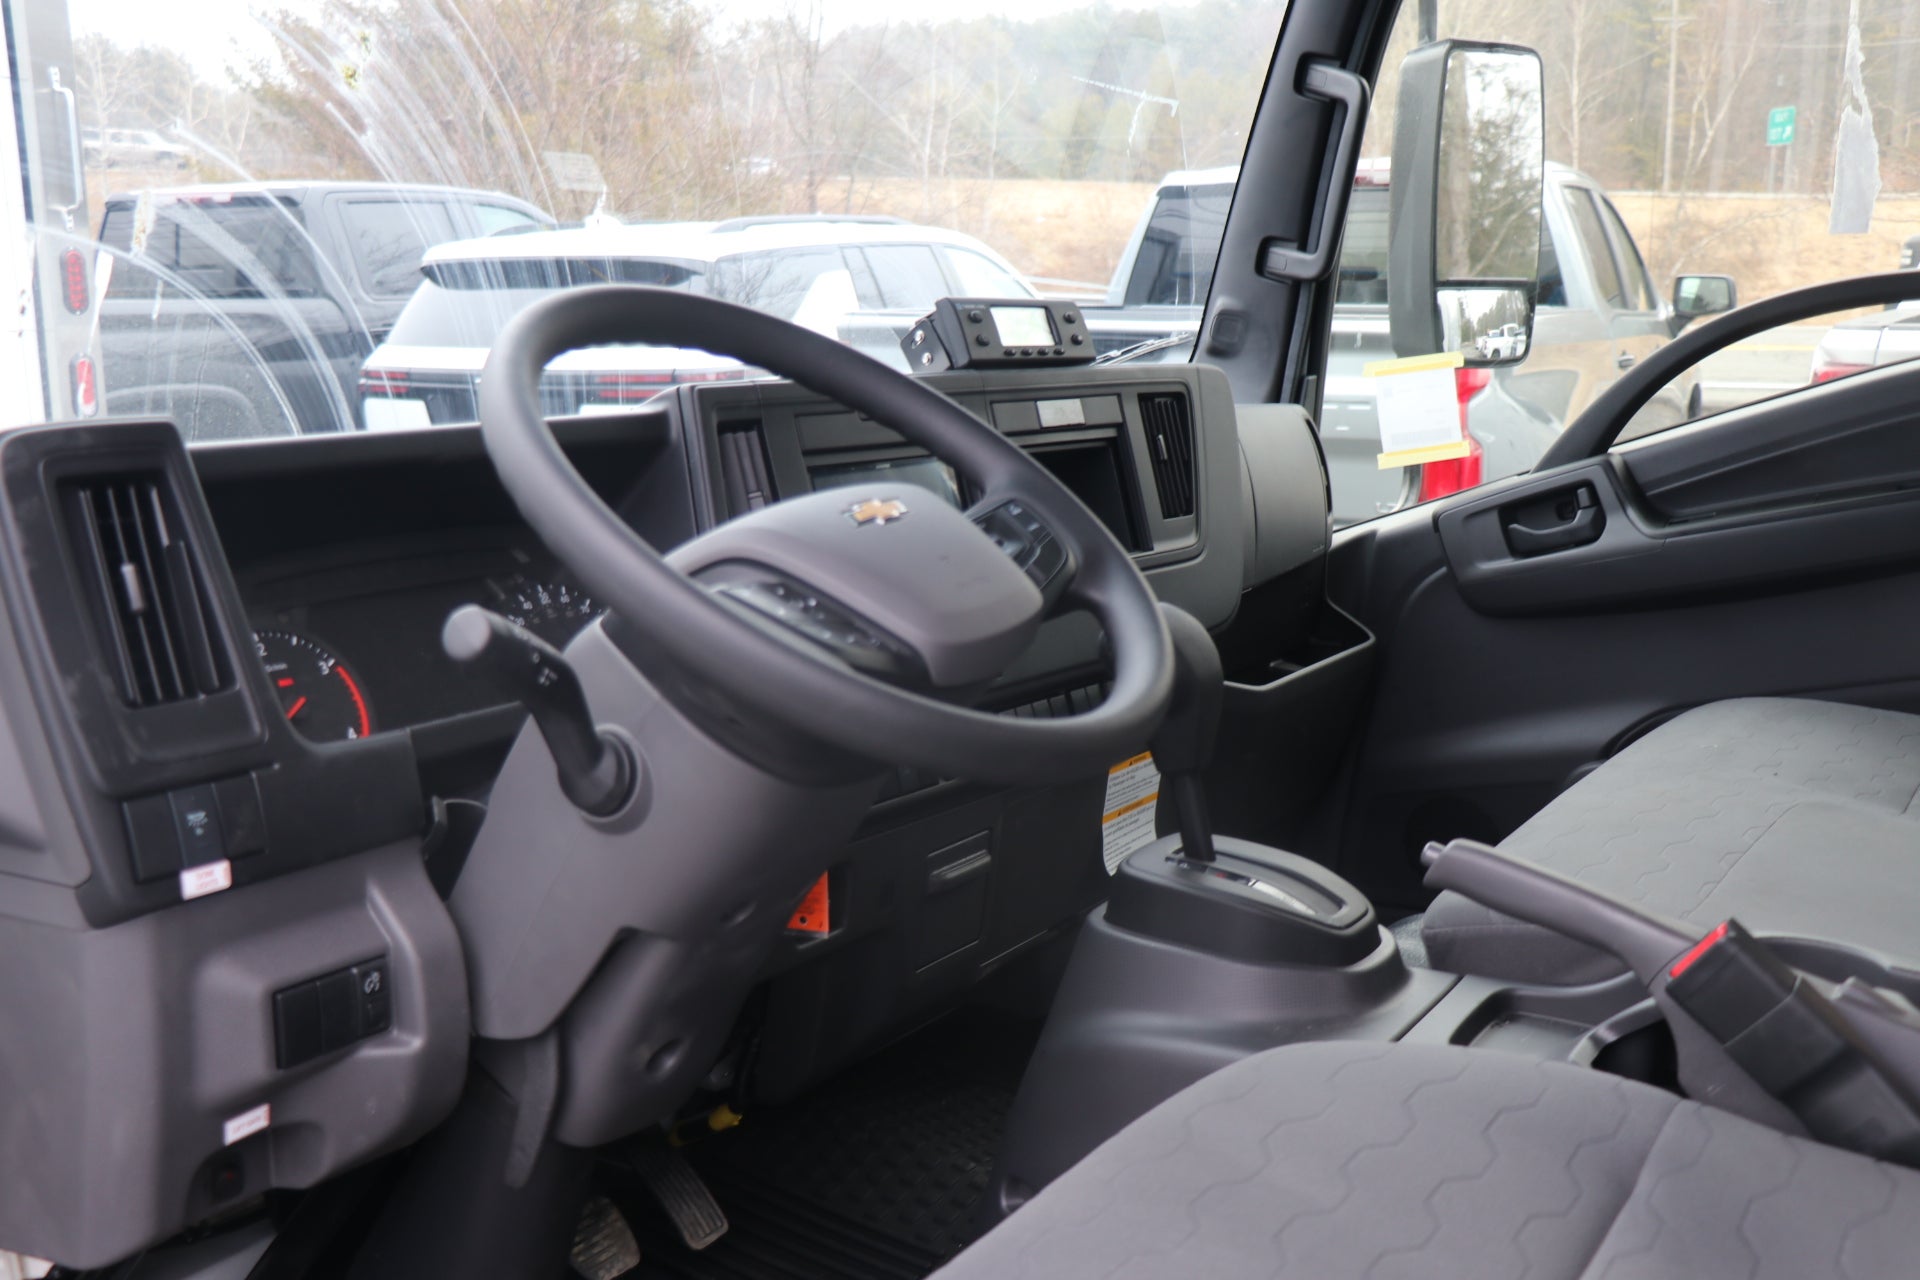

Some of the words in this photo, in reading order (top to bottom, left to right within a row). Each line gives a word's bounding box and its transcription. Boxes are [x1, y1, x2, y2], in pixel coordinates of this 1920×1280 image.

[256, 642, 268, 657] 2
[318, 660, 330, 676] 3
[347, 726, 358, 740] 4
